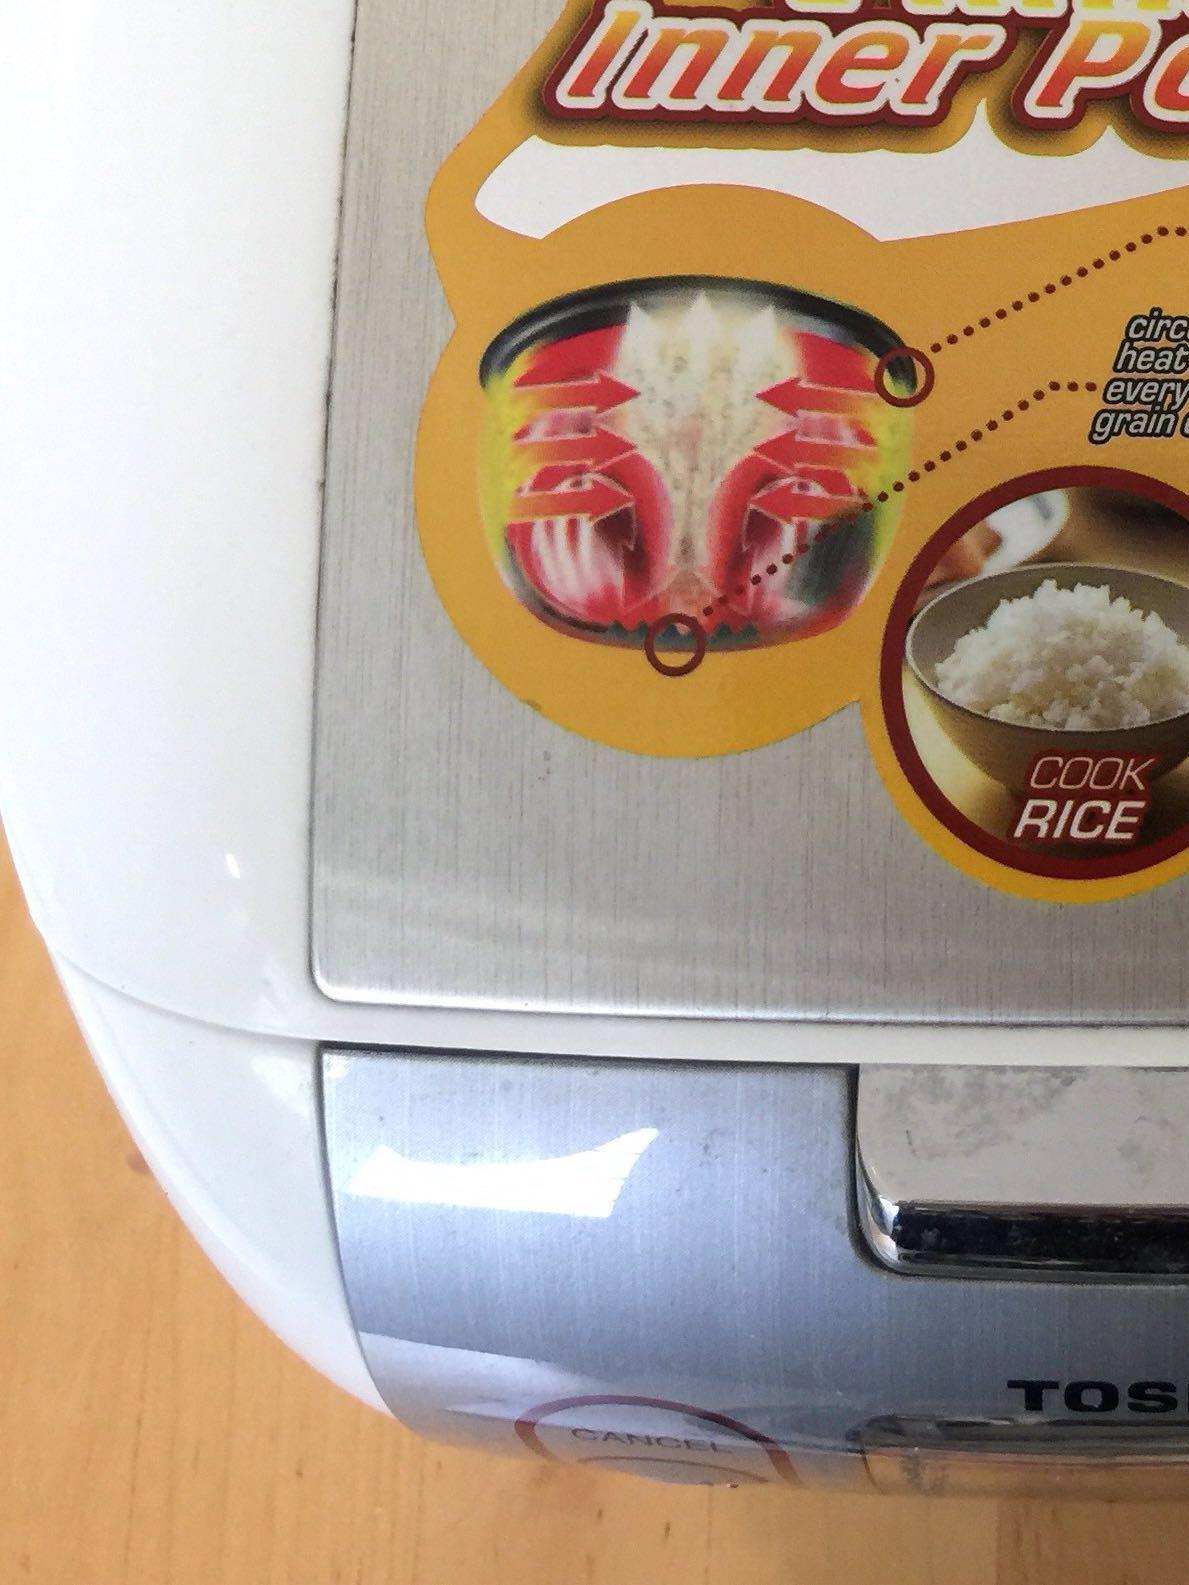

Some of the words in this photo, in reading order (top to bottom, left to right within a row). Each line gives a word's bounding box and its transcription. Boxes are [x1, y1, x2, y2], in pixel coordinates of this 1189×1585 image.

[554, 0, 1006, 117] Inner
[1116, 343, 1189, 373] heat
[1092, 408, 1176, 441] grain
[1028, 755, 1154, 792] COOK
[1013, 798, 1147, 841] RICE
[571, 1427, 734, 1454] CANCEL
